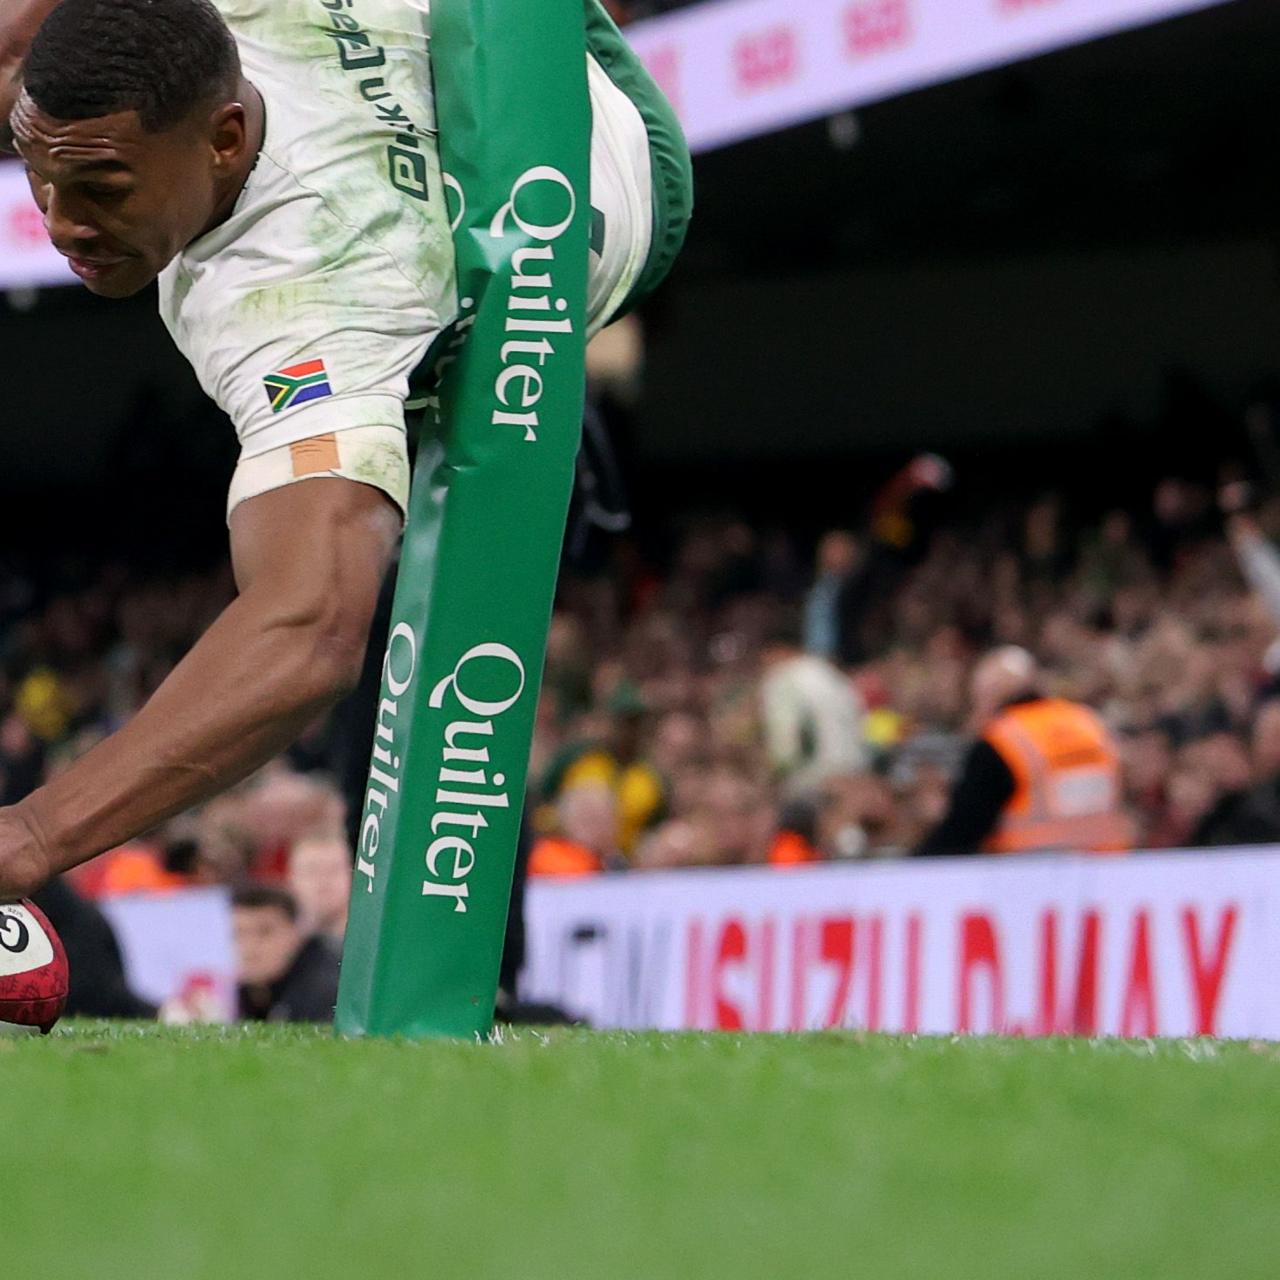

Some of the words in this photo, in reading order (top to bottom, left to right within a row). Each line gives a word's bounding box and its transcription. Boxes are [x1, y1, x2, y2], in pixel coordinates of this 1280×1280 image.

[490, 165, 576, 442] Quilter
[357, 622, 417, 894] Quilter
[421, 642, 526, 913] Quilter
